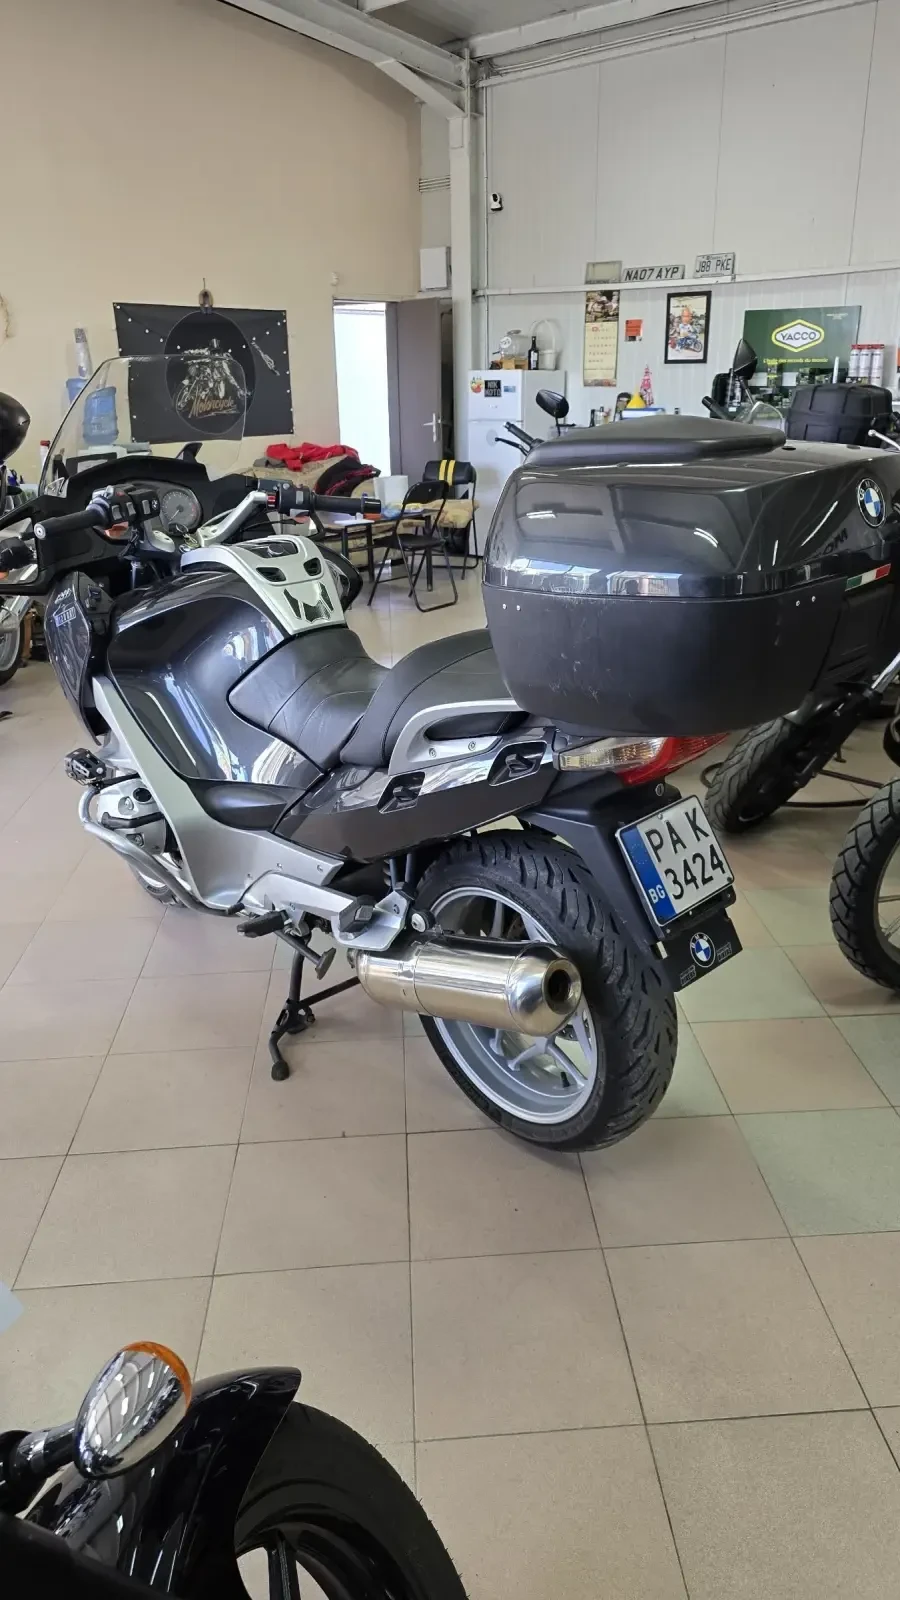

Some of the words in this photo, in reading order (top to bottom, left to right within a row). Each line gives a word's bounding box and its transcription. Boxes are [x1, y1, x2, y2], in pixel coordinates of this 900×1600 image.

[656, 267, 680, 279] AYP
[695, 260, 711, 273] J88
[715, 258, 732, 272] PKE
[780, 331, 817, 341] YACCO
[664, 843, 726, 900] 3424
[648, 884, 666, 904] BG
